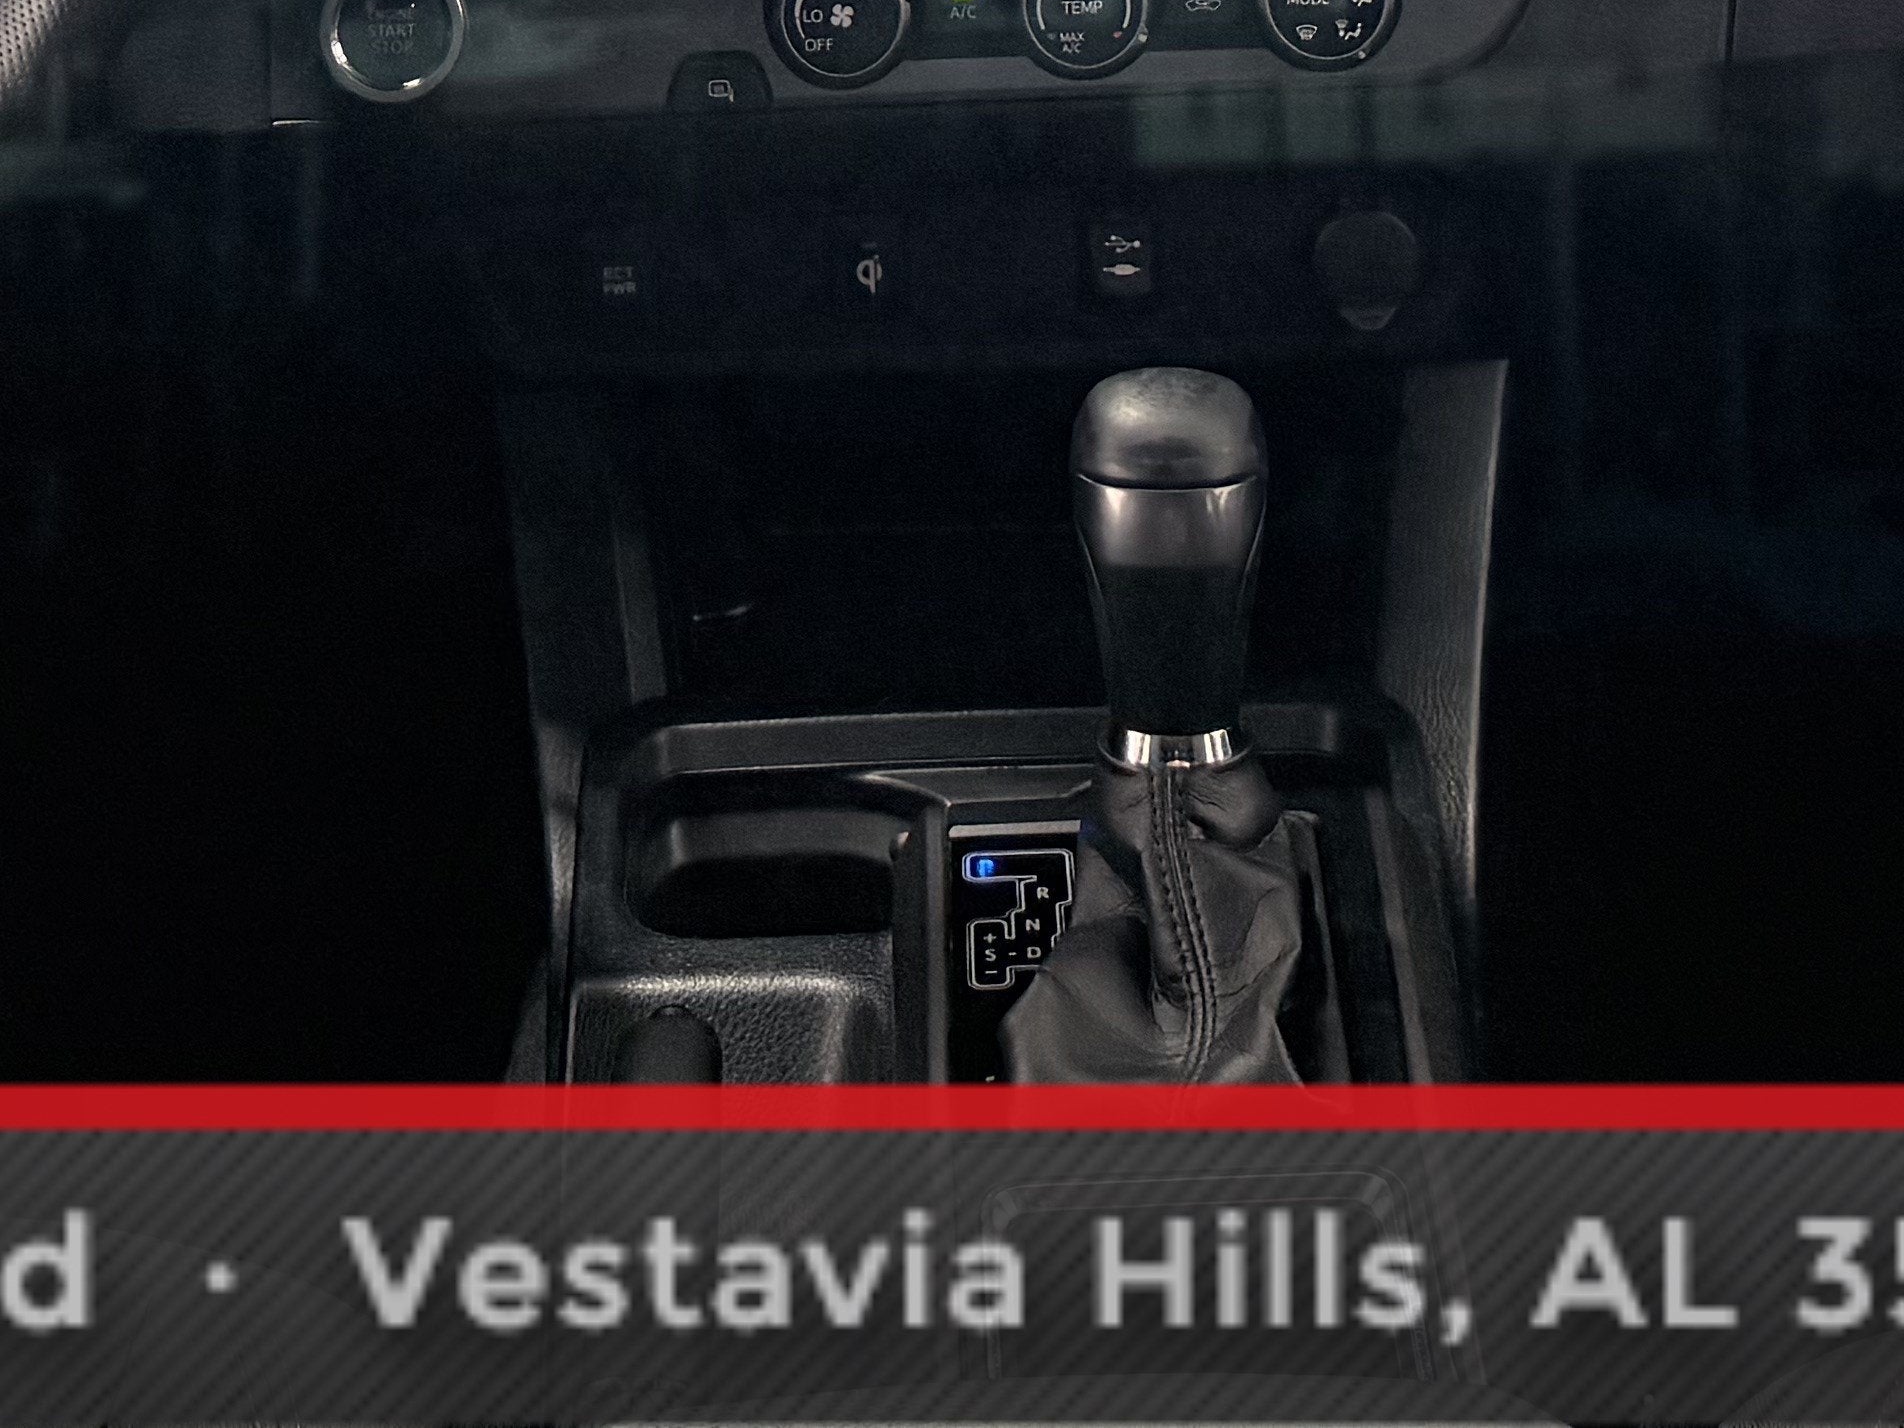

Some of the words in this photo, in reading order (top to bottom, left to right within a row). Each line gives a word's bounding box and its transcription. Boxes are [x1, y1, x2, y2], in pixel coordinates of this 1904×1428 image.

[949, 5, 976, 20] A/C
[1061, 0, 1103, 16] TEMP
[803, 9, 823, 23] LO
[367, 23, 415, 37] START
[1059, 31, 1085, 43] MAX
[804, 38, 834, 52] OFF
[1062, 43, 1082, 55] A/C
[1036, 886, 1050, 899] R
[1025, 919, 1041, 932] N
[984, 948, 997, 962] S
[1026, 945, 1042, 960] D
